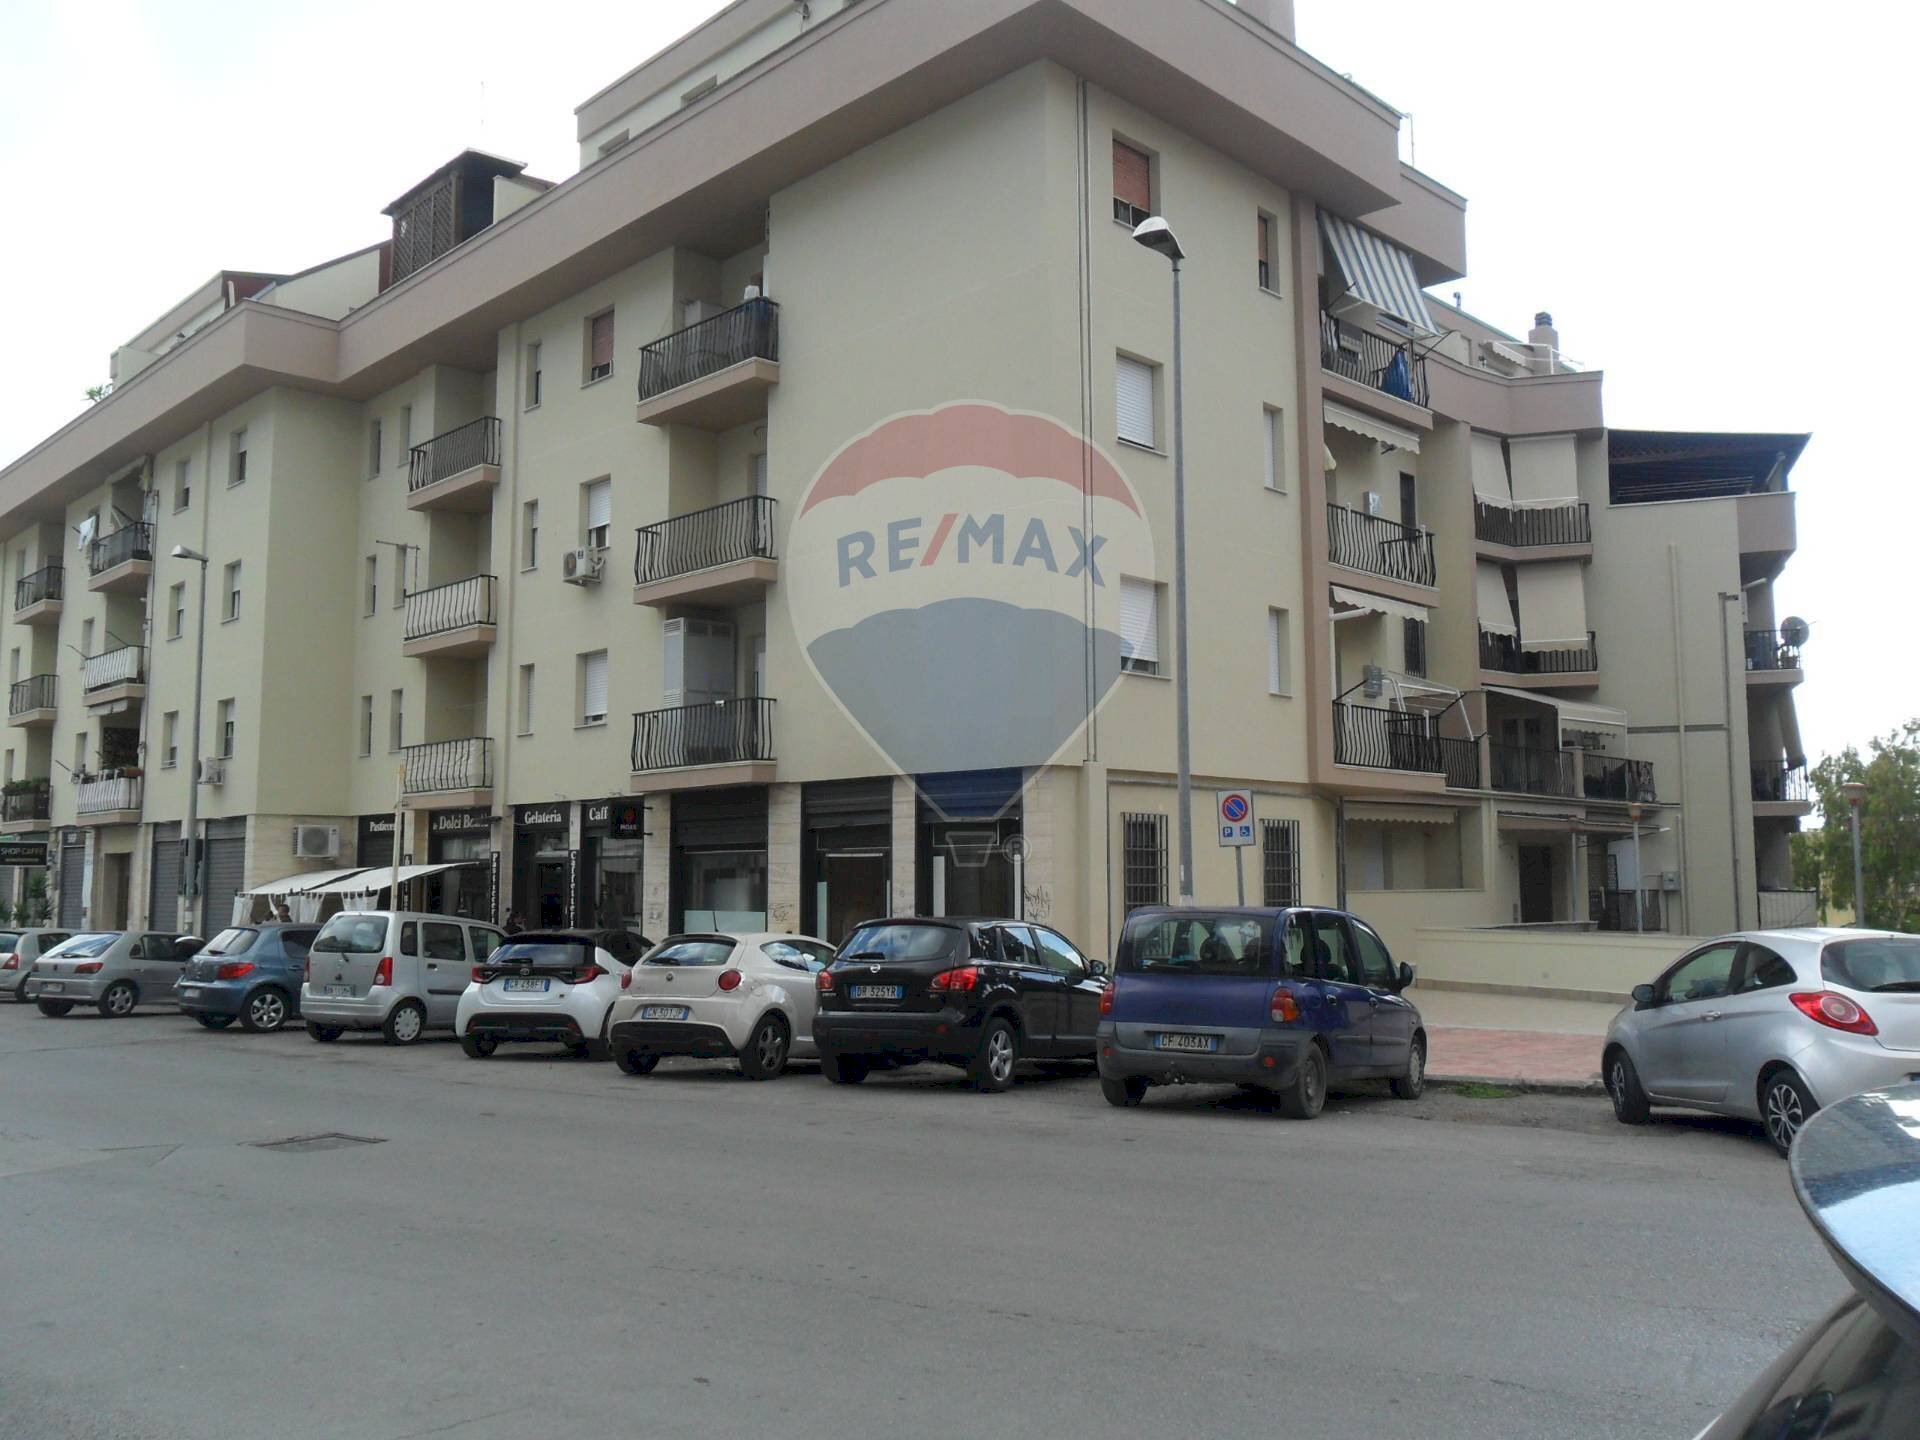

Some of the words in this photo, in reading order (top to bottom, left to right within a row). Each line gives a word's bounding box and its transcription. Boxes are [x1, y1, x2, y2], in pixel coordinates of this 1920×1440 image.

[439, 814, 461, 830] Dolci
[525, 809, 562, 825] Gelateria
[589, 807, 608, 821] Caff
